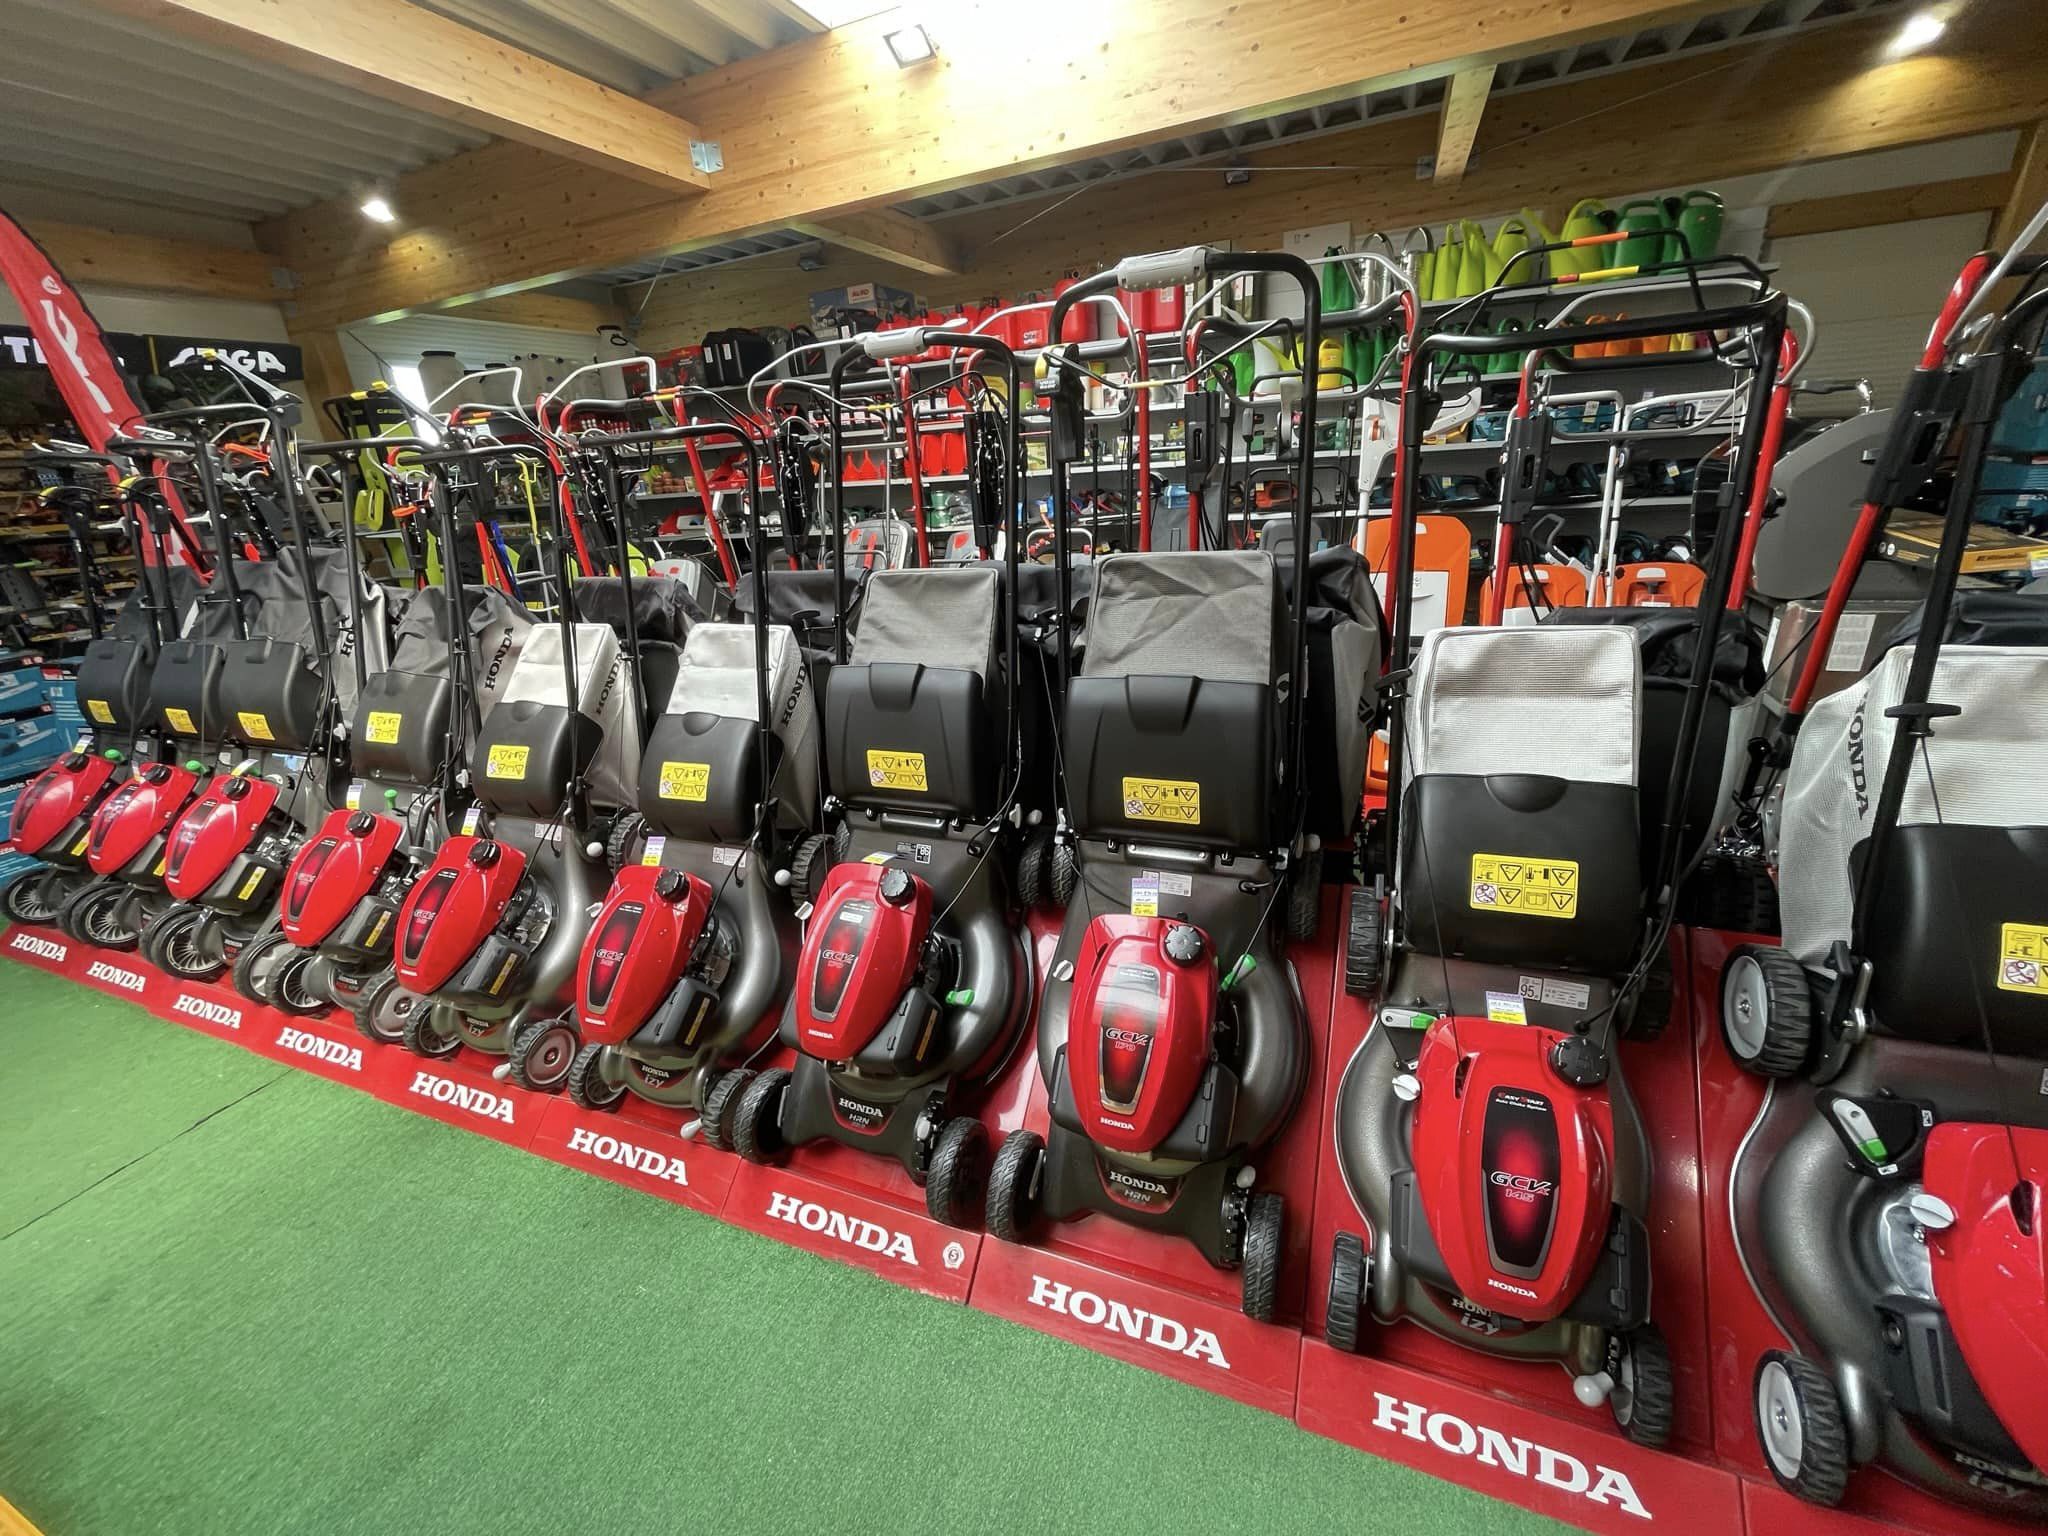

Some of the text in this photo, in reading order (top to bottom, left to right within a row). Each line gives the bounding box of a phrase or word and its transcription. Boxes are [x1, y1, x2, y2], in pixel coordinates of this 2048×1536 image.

[484, 627, 514, 690] HONDA
[781, 665, 806, 727] HOND
[10, 933, 67, 962] HONDA
[87, 961, 146, 992] HONDA
[1520, 984, 1535, 998] 95
[173, 994, 242, 1028] HONDA
[276, 1027, 363, 1071] HONDA
[808, 1028, 834, 1040] HONDA
[409, 1072, 515, 1124] HONDA
[839, 1098, 884, 1117] HONDA
[1100, 1117, 1135, 1131] HONDA
[567, 1127, 689, 1186] HONDA
[1109, 1170, 1168, 1195] HONDA
[1124, 1189, 1151, 1202] HRN
[1505, 1188, 1534, 1202] 145
[766, 1192, 919, 1265] HONDA
[1488, 1278, 1538, 1299] HONDA
[1027, 1274, 1231, 1369] HONDA
[1451, 1298, 1493, 1317] HON
[1372, 1391, 1653, 1520] HONDA
